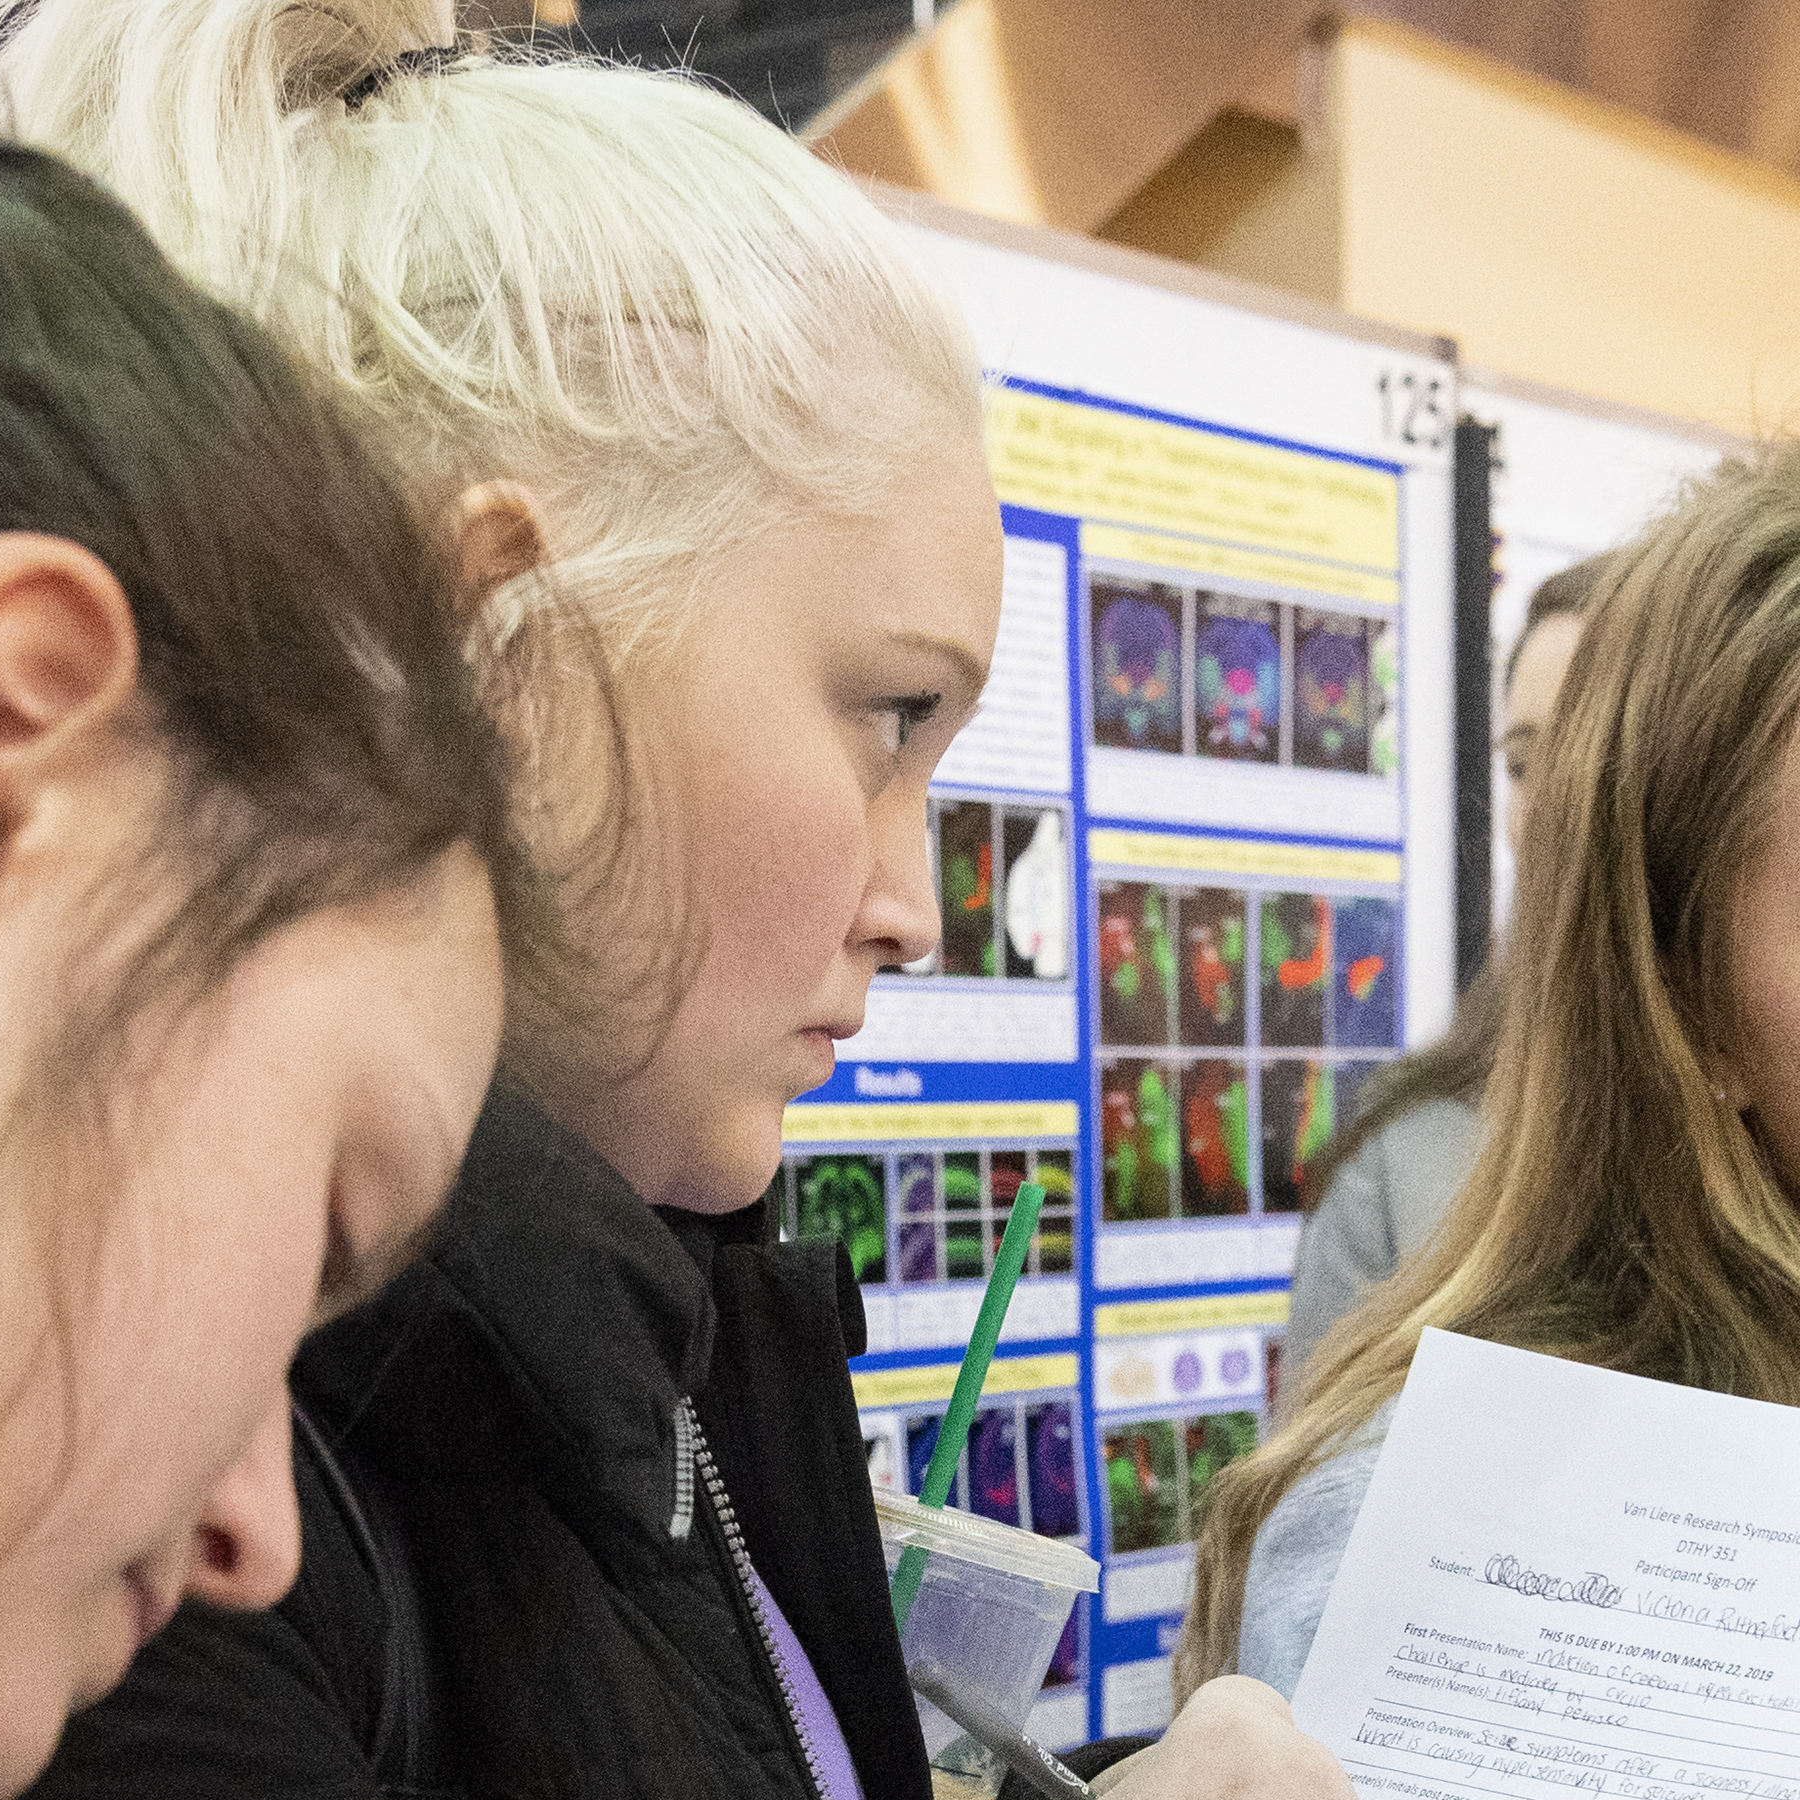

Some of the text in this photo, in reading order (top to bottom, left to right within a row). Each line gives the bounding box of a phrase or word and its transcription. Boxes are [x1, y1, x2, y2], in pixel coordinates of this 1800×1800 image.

[1623, 1500, 1647, 1517] Van
[1649, 1506, 1681, 1524] Liere
[1683, 1512, 1740, 1535] Research
[1428, 1556, 1476, 1577] Student:
[1676, 1539, 1738, 1562] DTHY 351
[1635, 1559, 1759, 1592] Participant Sign-Off
[1403, 1622, 1529, 1660] First Presentation Name:
[1539, 1627, 1774, 1682] THIS IS DUE BY 1:00 PM ON MARCH 22, 2019
[1385, 1665, 1491, 1699] Presenter(s) Name(s):
[1365, 1707, 1475, 1741] Presentation Overview:
